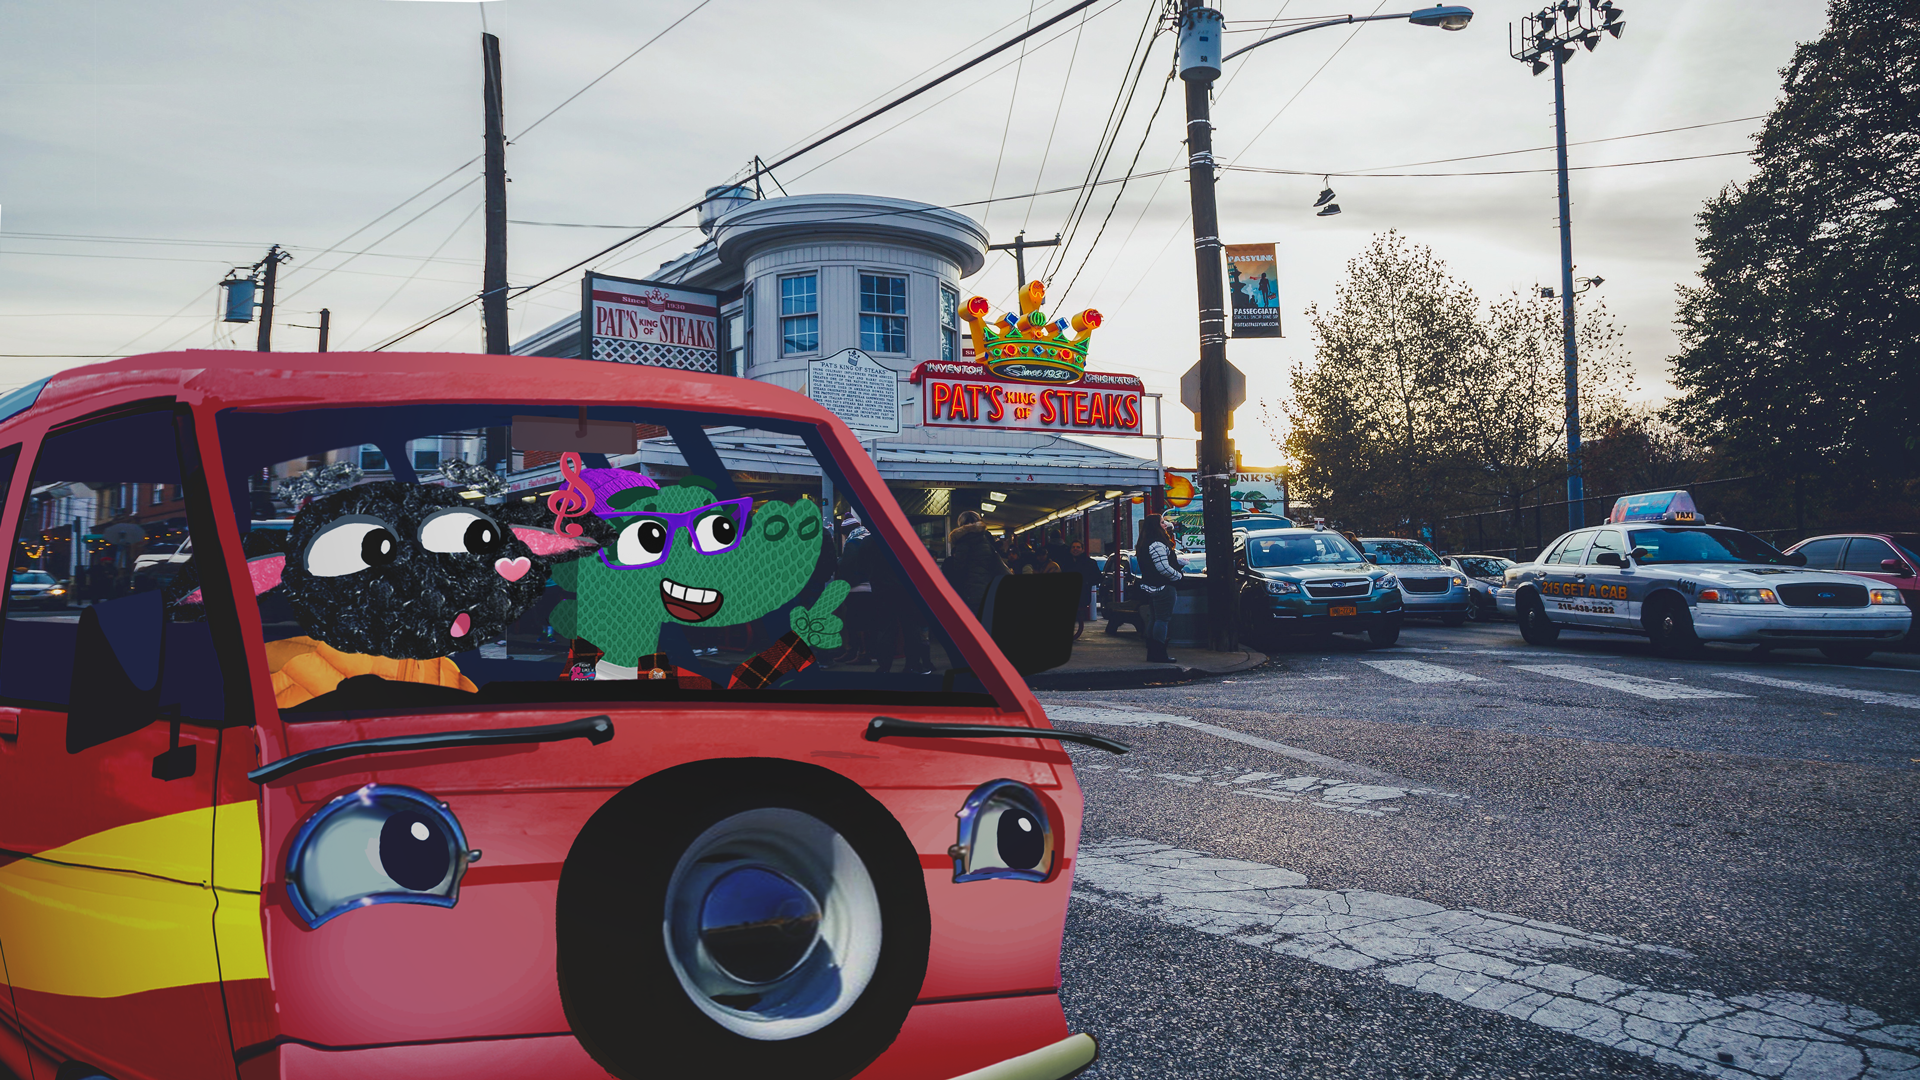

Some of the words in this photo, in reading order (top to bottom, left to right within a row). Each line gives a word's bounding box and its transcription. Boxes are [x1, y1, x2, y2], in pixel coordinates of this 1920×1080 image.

[622, 296, 646, 304] Since
[596, 306, 638, 339] PAT'S
[639, 319, 658, 327] KING
[660, 314, 715, 349] STEAKS
[1004, 365, 1043, 376] Since
[1043, 369, 1070, 380] 1930
[932, 382, 1004, 421] PAT'S
[1006, 392, 1036, 405] KING
[1015, 407, 1031, 420] OF
[1041, 389, 1139, 428] STEAKS
[1542, 581, 1560, 594] 215
[1562, 583, 1586, 597] GET
[1588, 585, 1596, 597] A
[1601, 585, 1627, 599] CAB
